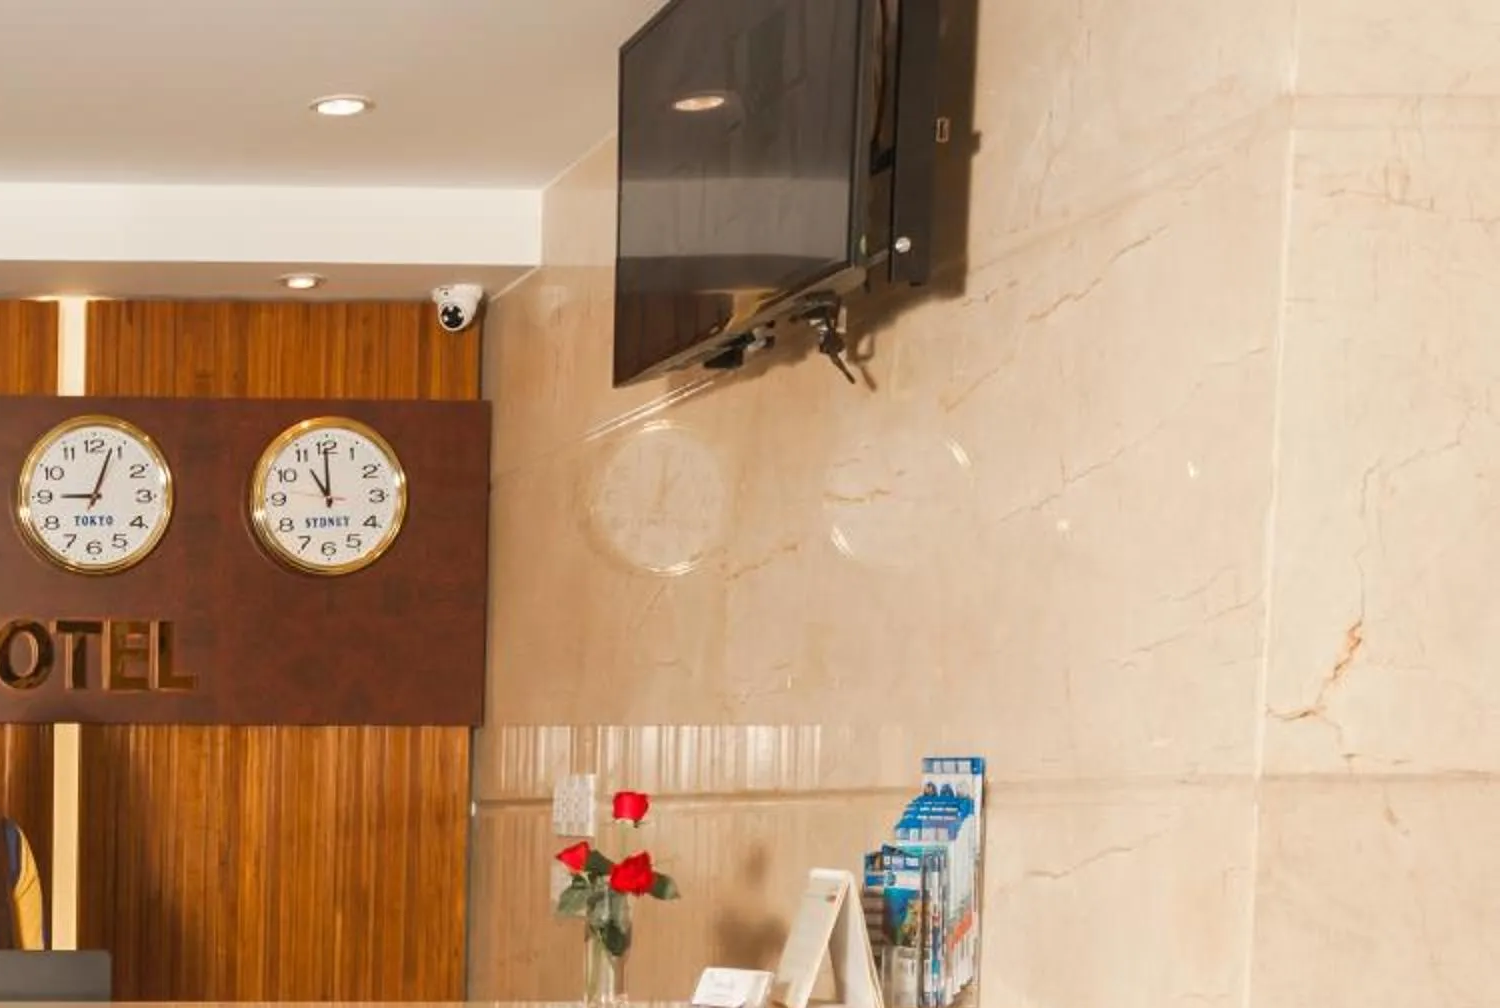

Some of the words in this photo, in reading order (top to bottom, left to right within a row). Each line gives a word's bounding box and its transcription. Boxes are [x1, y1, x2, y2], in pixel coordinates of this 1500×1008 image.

[84, 440, 104, 452] 12
[316, 441, 338, 454] 12
[64, 447, 74, 460] 11
[296, 450, 308, 462] 11
[45, 466, 64, 480] 10
[130, 464, 145, 478] 2
[278, 469, 297, 483] 10
[363, 464, 378, 478] 2
[37, 490, 53, 504] 9
[136, 490, 151, 503] 3
[271, 492, 286, 506] 9
[369, 489, 384, 503] 3
[44, 516, 60, 530] 8
[74, 516, 113, 526] TOKYO
[130, 516, 143, 528] 4
[279, 518, 294, 532] 8
[305, 517, 350, 528] SYDNEY
[363, 516, 376, 528] 4
[64, 534, 76, 548] 7
[86, 540, 102, 554] 6
[112, 534, 128, 548] 5
[298, 536, 311, 550] 7
[346, 534, 362, 548] 5
[321, 542, 337, 556] 6
